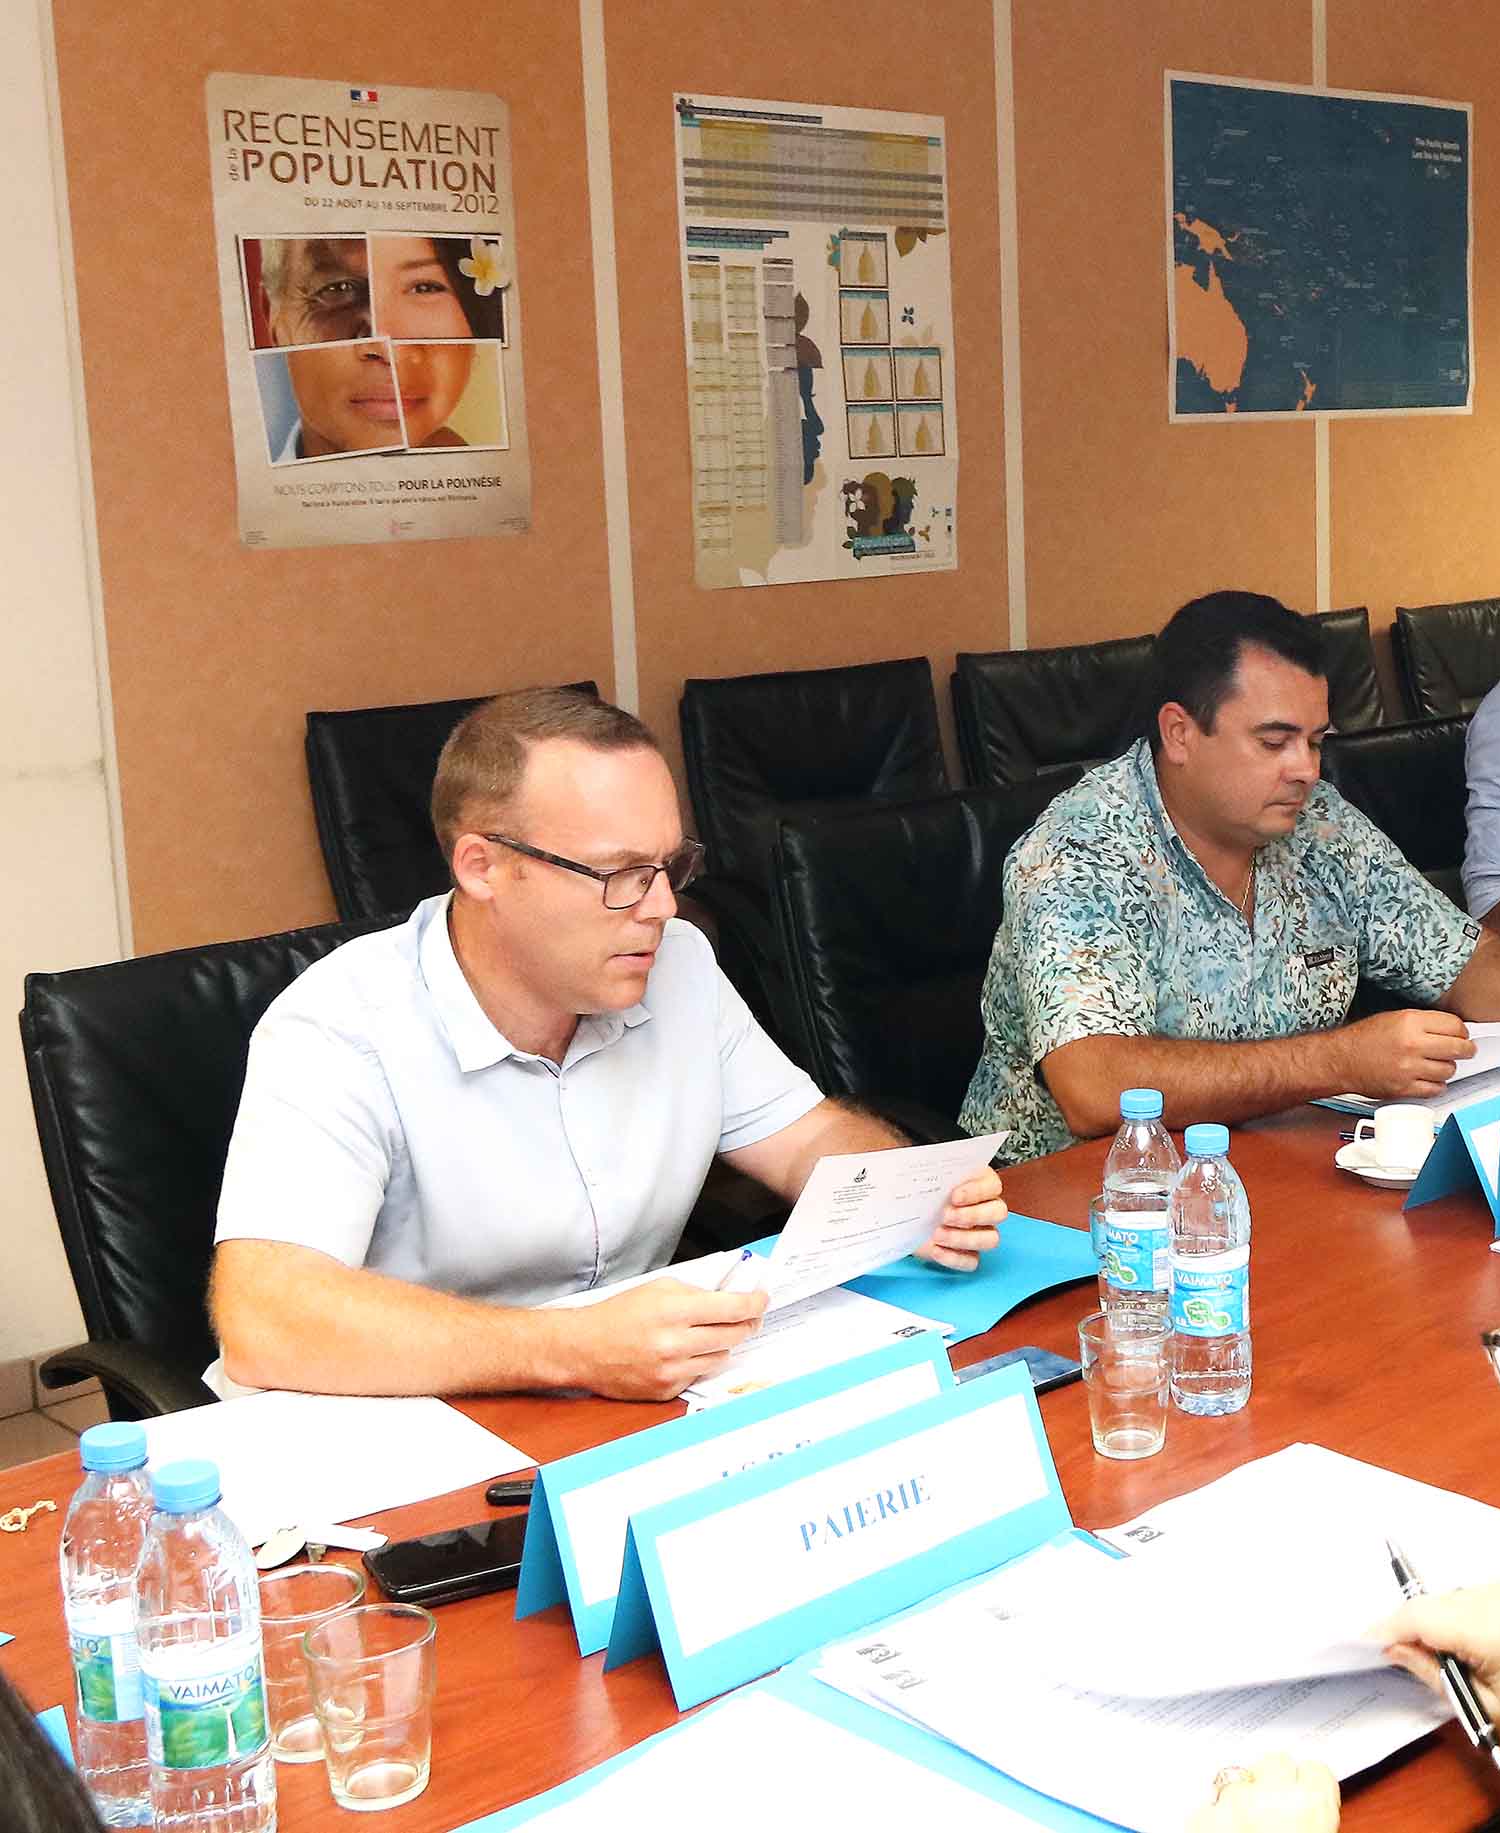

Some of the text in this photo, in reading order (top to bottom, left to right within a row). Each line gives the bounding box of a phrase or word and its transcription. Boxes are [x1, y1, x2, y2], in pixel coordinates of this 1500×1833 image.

[222, 109, 500, 157] RECENSEMENT
[242, 149, 497, 194] POPULATION
[451, 193, 500, 215] 2012
[398, 479, 428, 490] POUR
[431, 479, 444, 490] LA
[446, 476, 502, 489] POLYNÉSIE
[1175, 1271, 1233, 1286] VAIMATO
[799, 1473, 932, 1552] PAIERIE
[169, 1664, 255, 1700] VAIMATO
